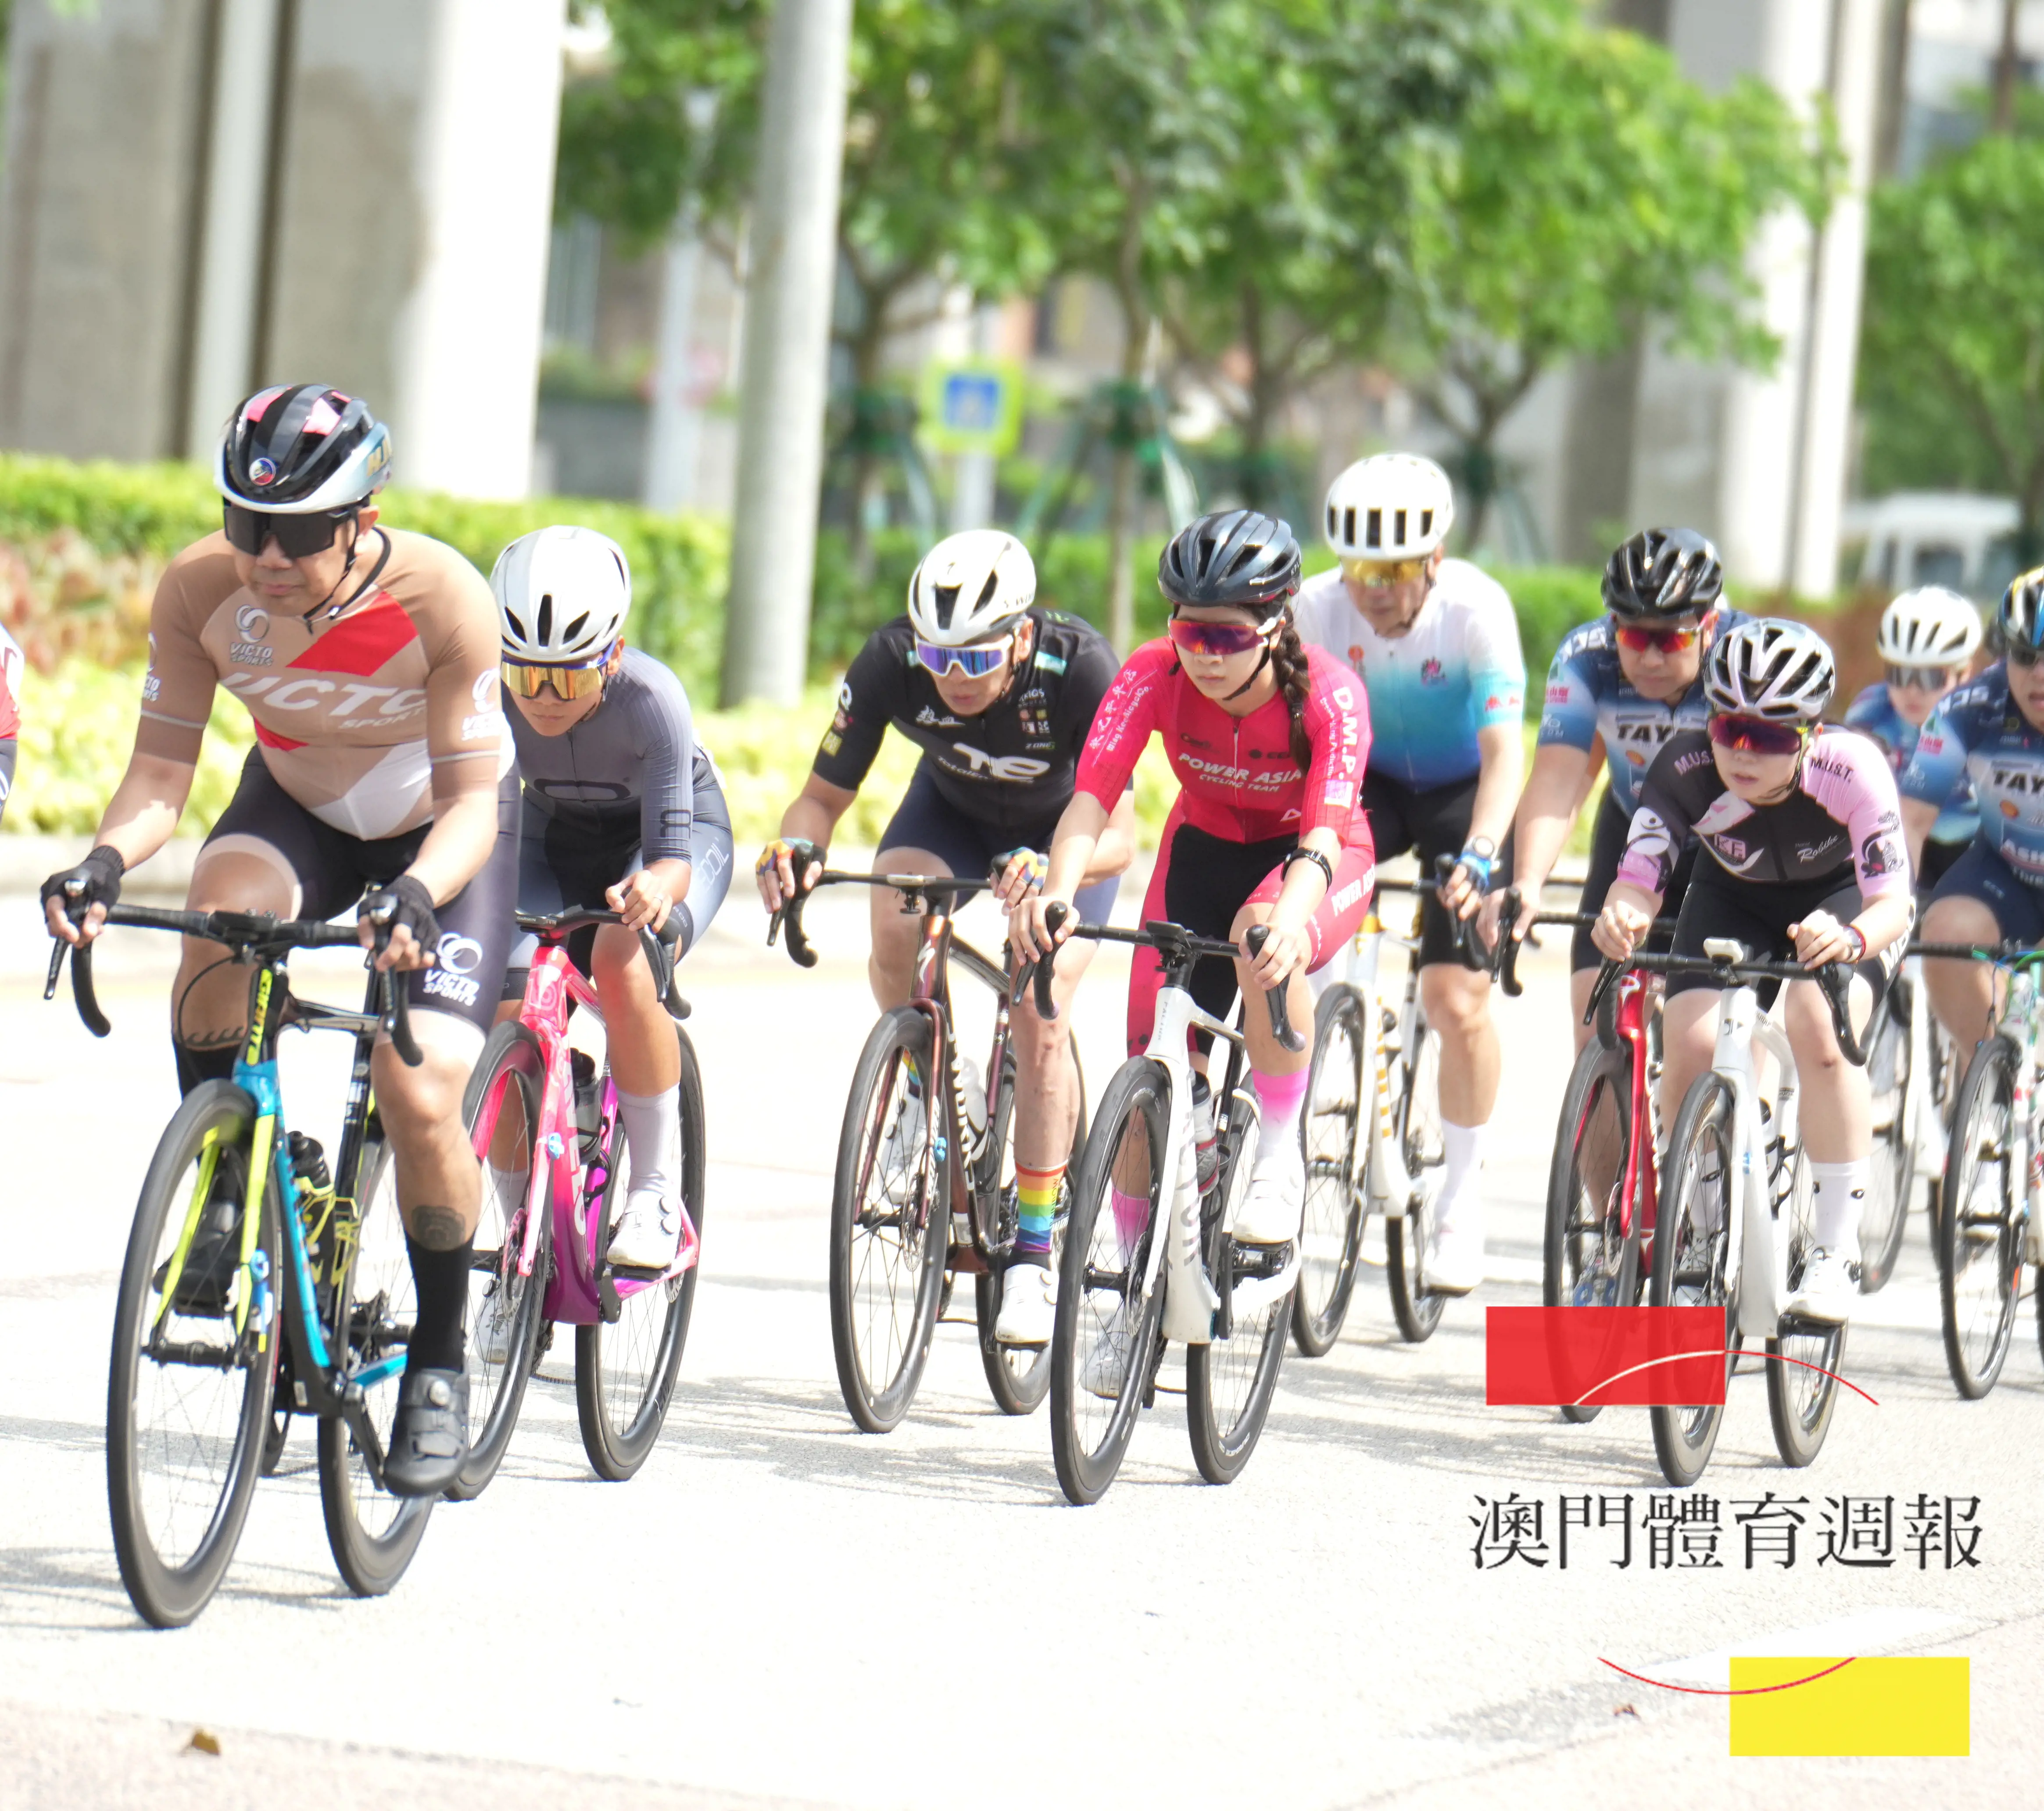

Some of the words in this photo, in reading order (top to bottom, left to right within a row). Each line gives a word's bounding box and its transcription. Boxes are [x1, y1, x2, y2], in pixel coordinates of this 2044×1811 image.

[229, 641, 273, 658] VICTO
[1178, 752, 1250, 780] POWER
[1253, 769, 1302, 784] ASIA
[424, 969, 480, 994] VICTO
